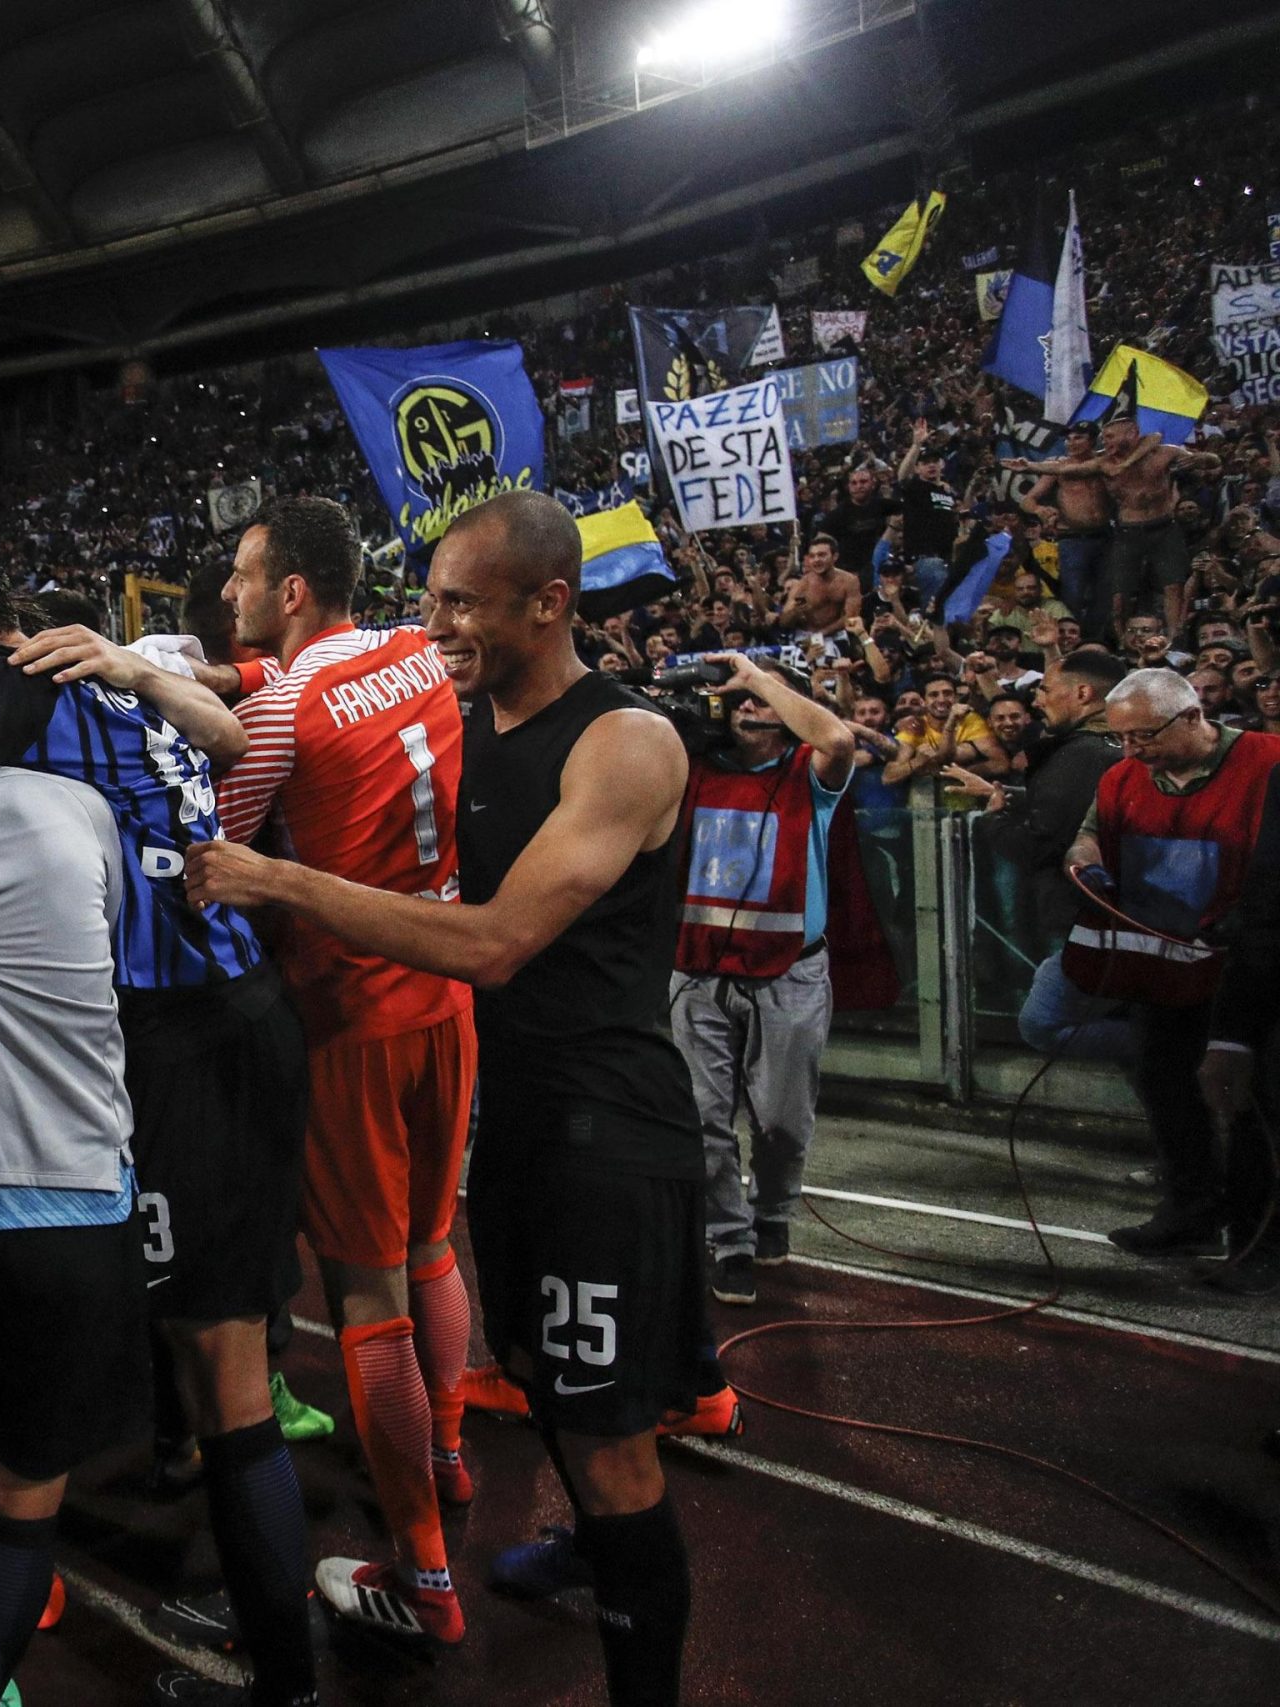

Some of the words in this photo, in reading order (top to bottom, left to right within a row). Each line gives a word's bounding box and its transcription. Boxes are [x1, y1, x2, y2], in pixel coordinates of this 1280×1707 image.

[656, 382, 777, 433] PAZZO
[679, 469, 785, 521] FEDE
[398, 722, 439, 865] 1
[541, 1274, 618, 1366] 25
